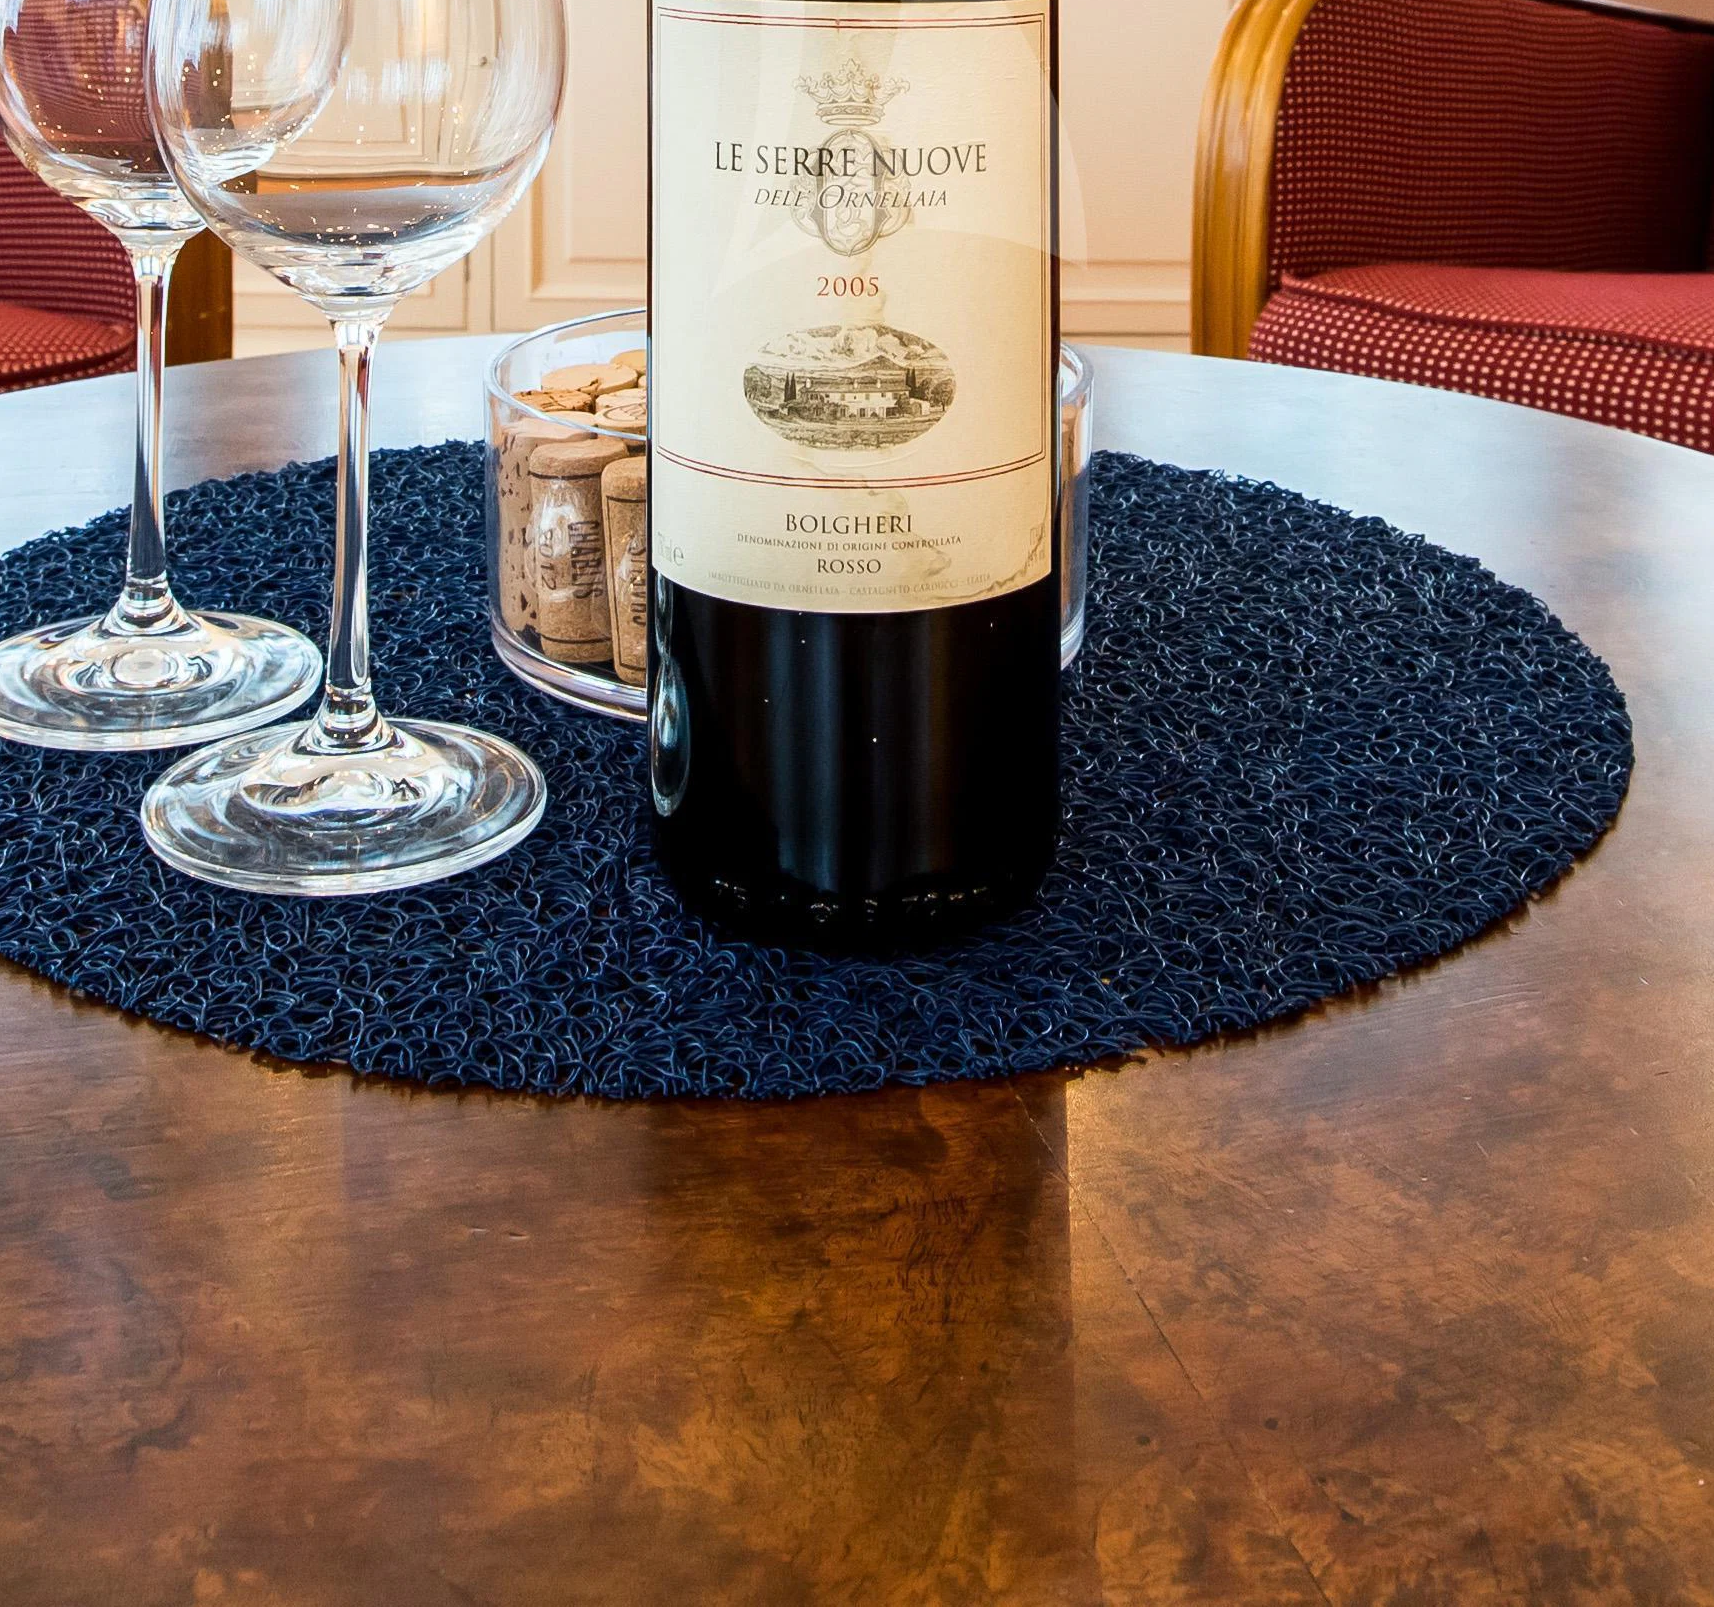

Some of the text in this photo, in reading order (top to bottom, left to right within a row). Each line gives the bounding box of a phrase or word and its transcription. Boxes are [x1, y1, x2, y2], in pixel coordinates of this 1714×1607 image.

[714, 141, 986, 177] LE SERRE NUOVE
[818, 184, 948, 209] ORNELLAIA
[816, 276, 880, 298] 2005
[785, 513, 913, 535] BOLGHERI
[737, 532, 962, 551] DENOMINAZIONE DI ORIGINE CONTROLLATA
[538, 528, 557, 591] 2012
[568, 519, 604, 600] CHABLIS
[816, 558, 882, 575] ROSSO
